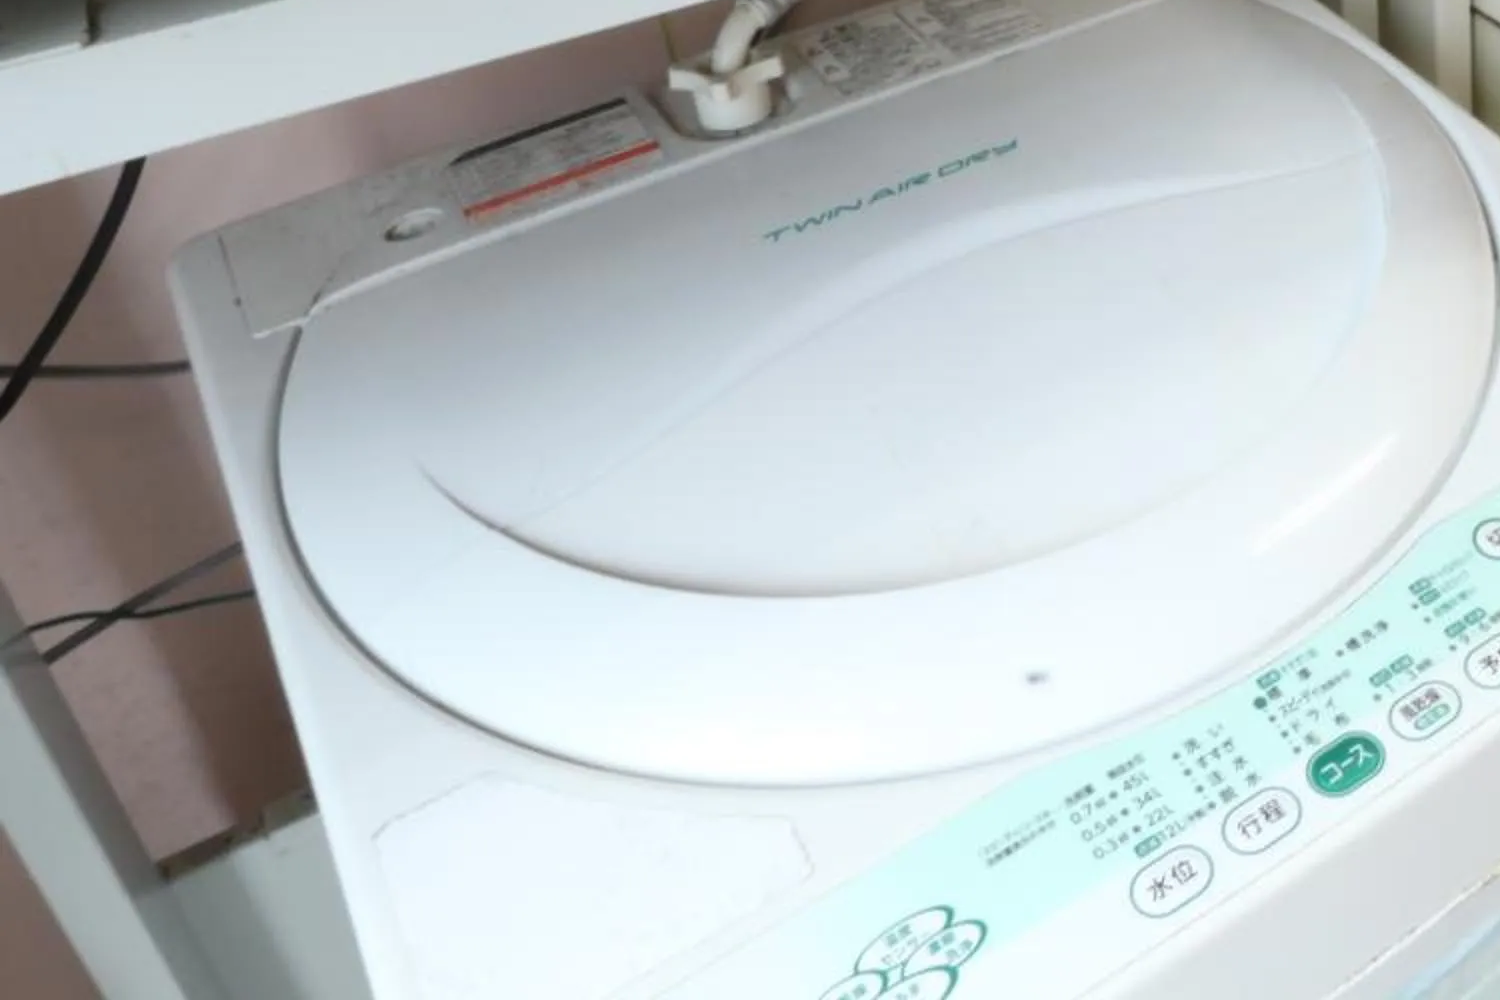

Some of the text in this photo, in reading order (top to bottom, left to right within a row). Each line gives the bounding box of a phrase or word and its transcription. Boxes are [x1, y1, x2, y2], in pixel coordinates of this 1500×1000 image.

[763, 136, 1018, 242] TWIN AIR DRY
[1318, 743, 1376, 786] コース
[1237, 798, 1287, 840] 行程
[1146, 858, 1199, 902] 水位
